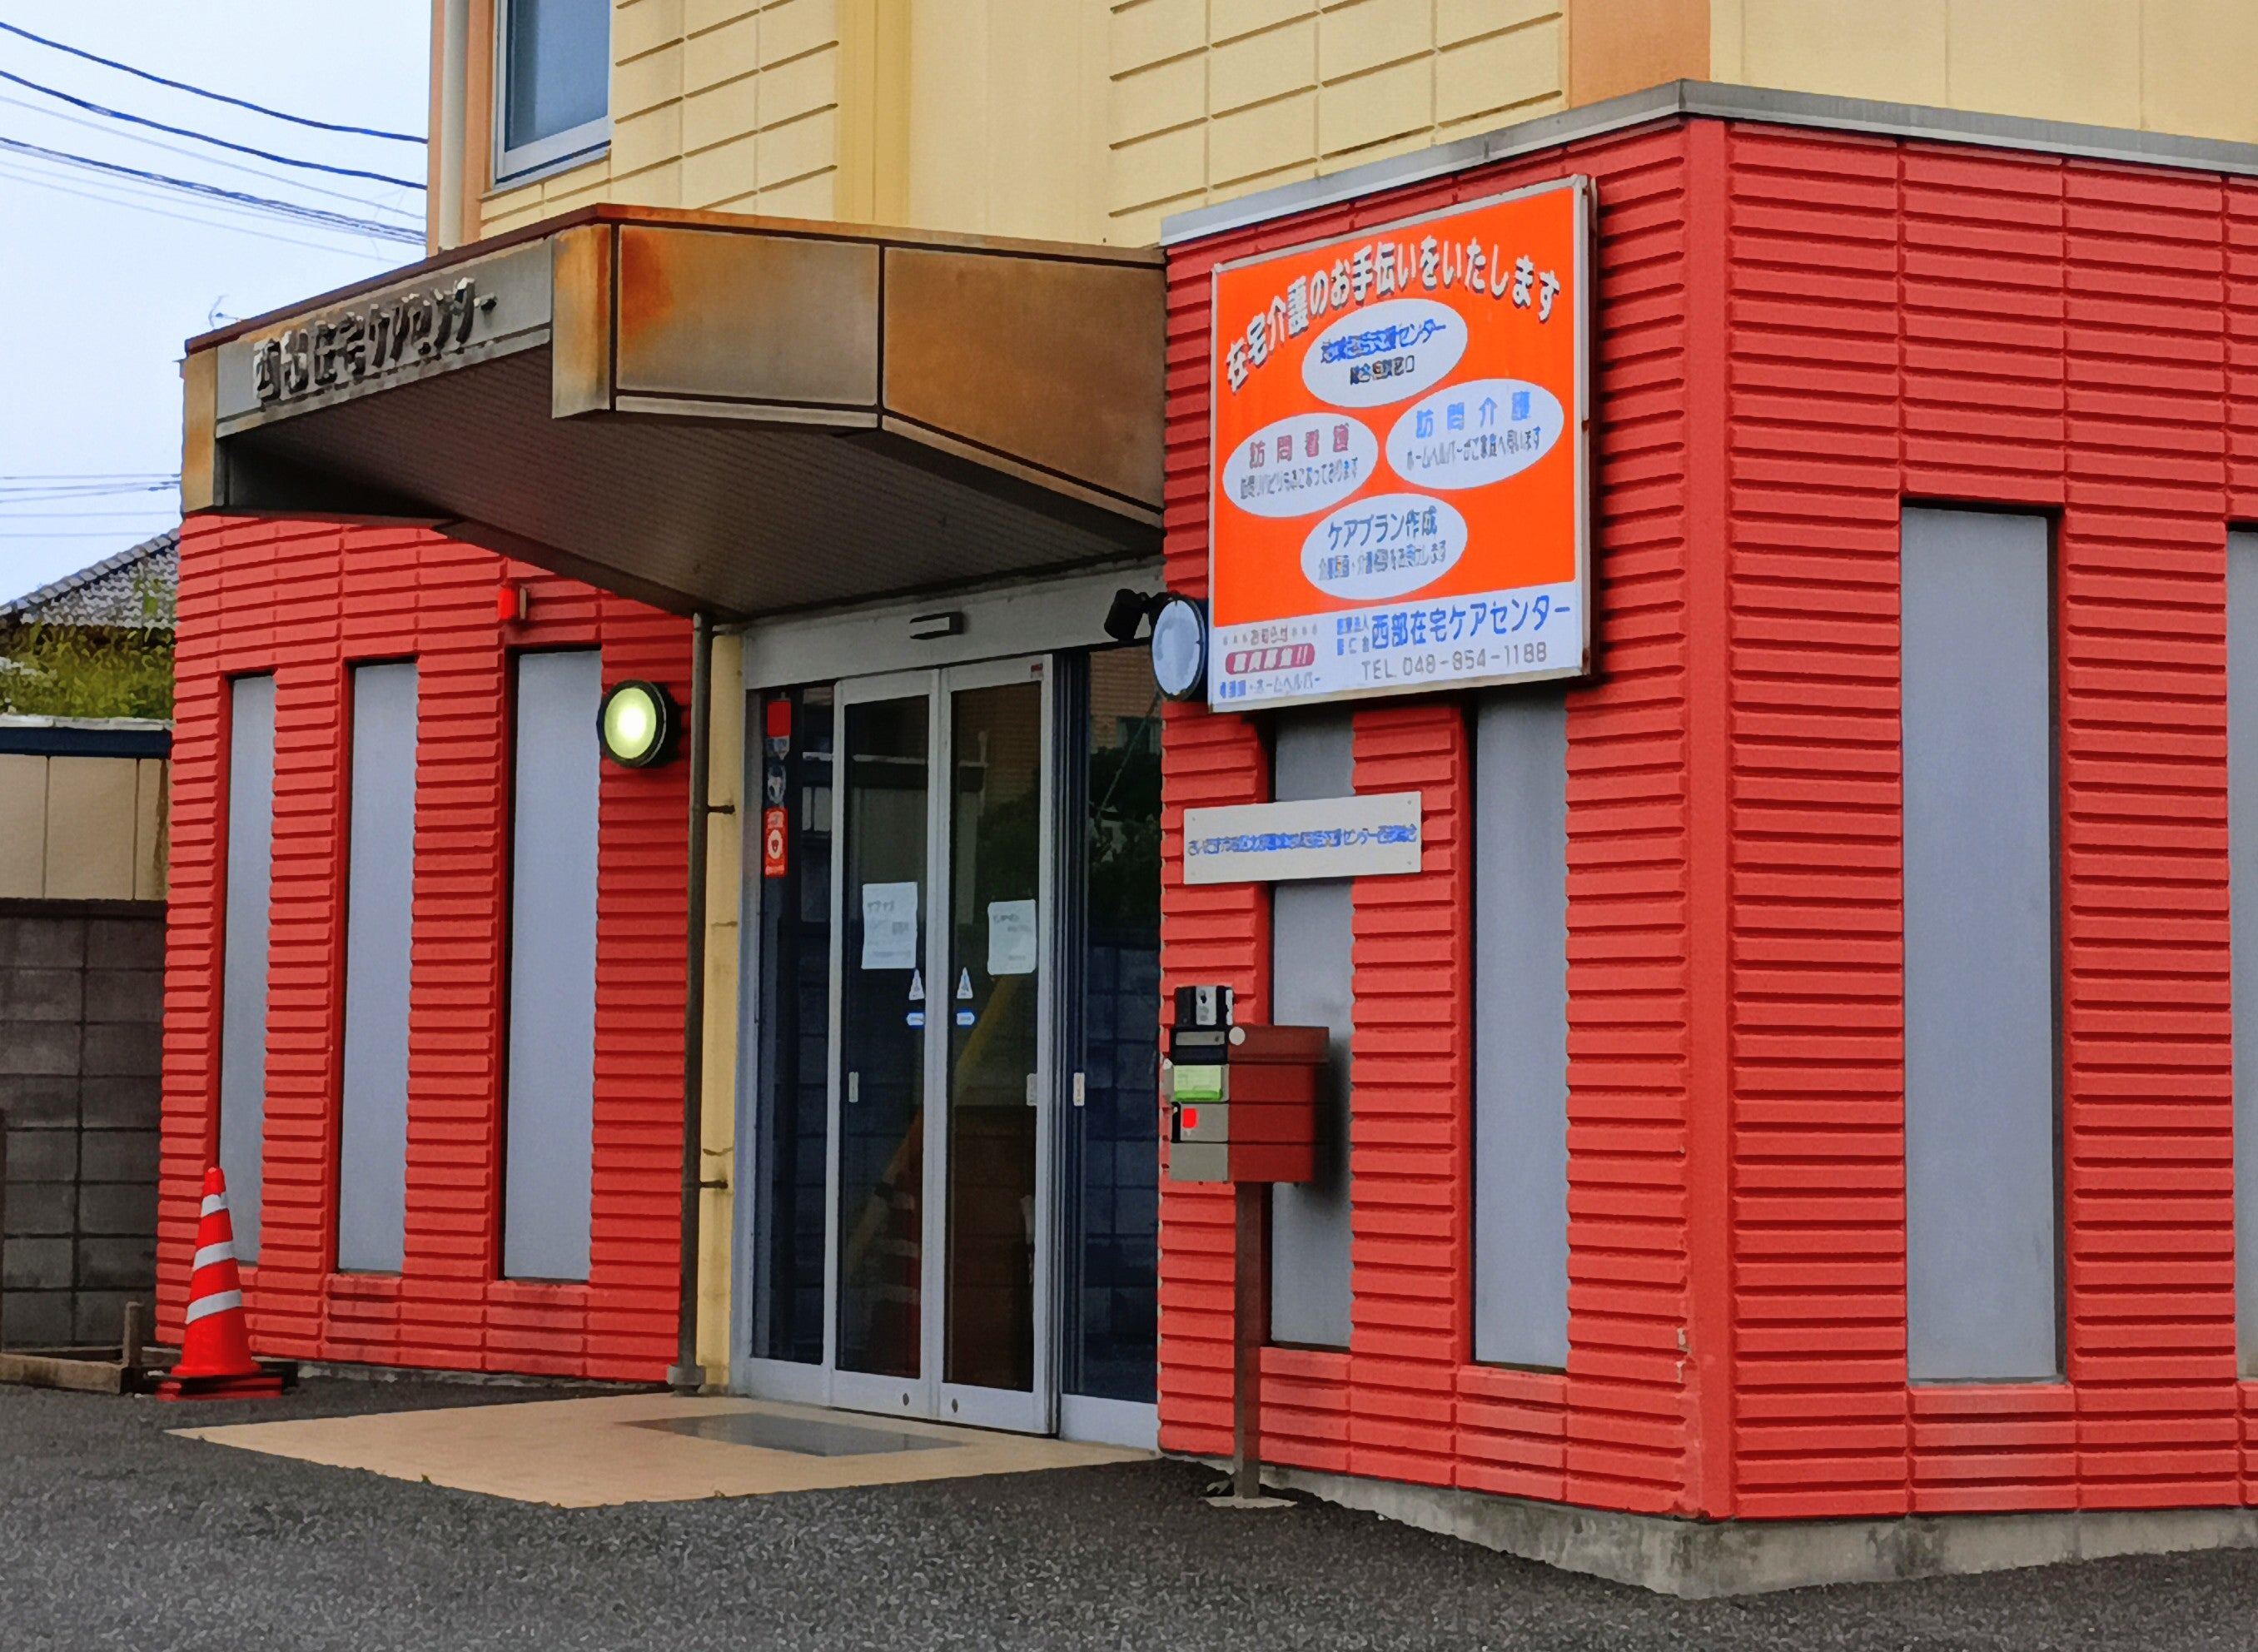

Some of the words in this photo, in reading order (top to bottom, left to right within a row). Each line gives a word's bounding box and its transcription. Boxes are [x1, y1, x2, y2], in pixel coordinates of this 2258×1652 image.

[1226, 236, 1560, 392] 在宅介護のお手伝いをいたします
[1327, 505, 1438, 550] ケアプラン作成
[1371, 595, 1570, 649] 西部在宅ケアセンター
[1403, 641, 1547, 676] 048-854-1188
